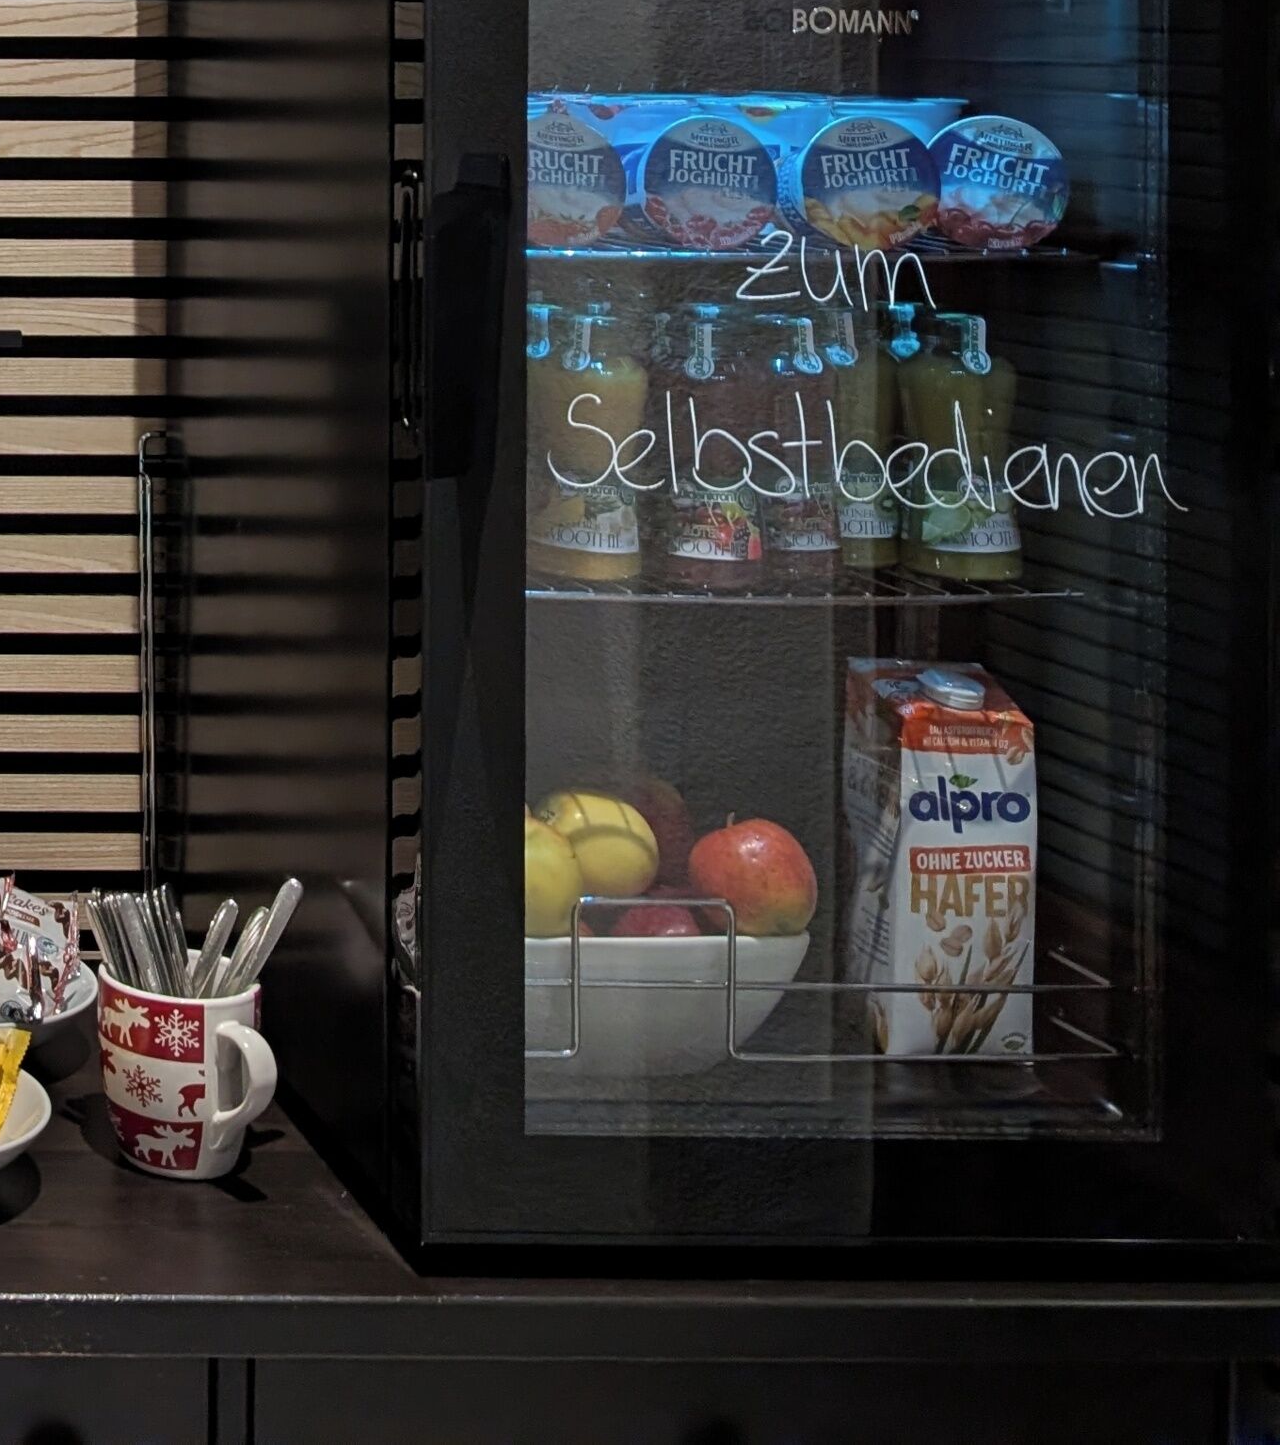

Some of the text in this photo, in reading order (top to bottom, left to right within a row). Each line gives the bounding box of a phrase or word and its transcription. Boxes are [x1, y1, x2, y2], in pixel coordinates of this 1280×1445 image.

[791, 5, 913, 35] BOMANN
[528, 149, 604, 174] RUCHT
[669, 149, 758, 175] FRUCHT
[820, 148, 911, 175] FRUCHT
[949, 143, 1050, 183] FRUCHT
[528, 169, 599, 187] OGHURT
[668, 167, 753, 189] JOGHURT
[824, 167, 911, 189] JOGHURT
[943, 162, 1043, 196] JOGHURT
[546, 389, 1190, 519] Selbstbedienen
[908, 776, 1031, 834] alpro
[917, 849, 1025, 870] OHNE ZUCKER
[910, 873, 1030, 918] HAFER
